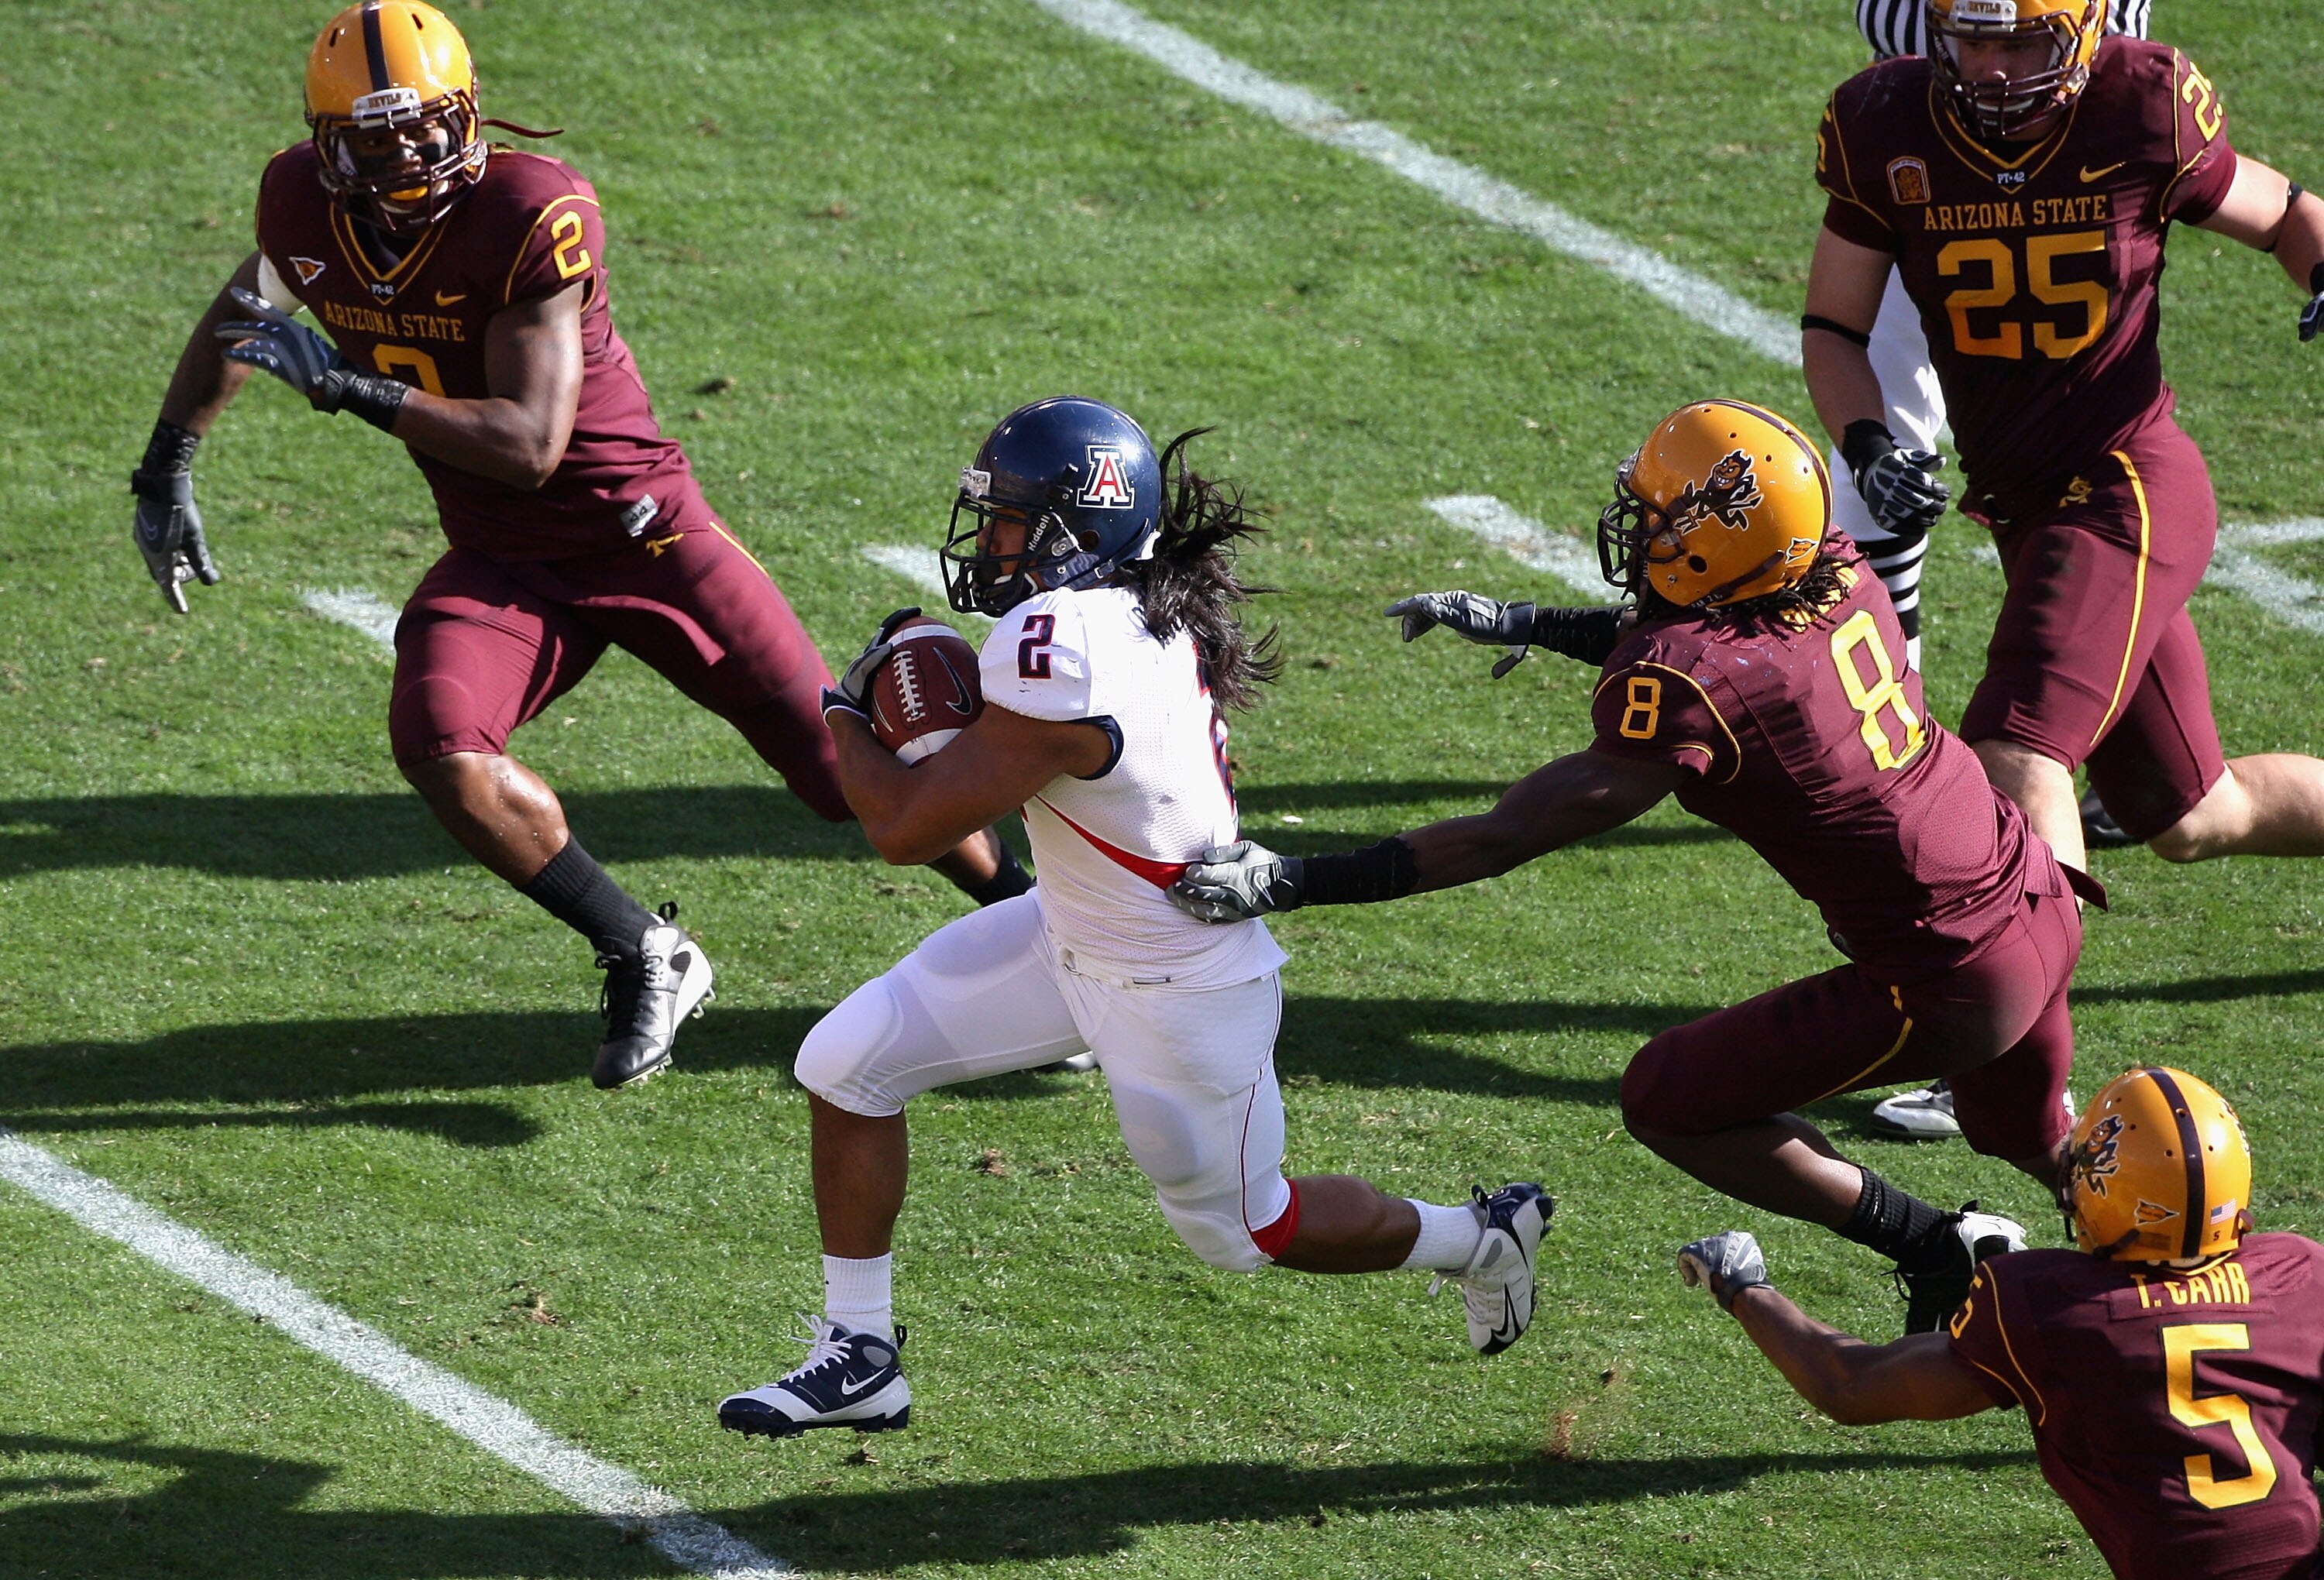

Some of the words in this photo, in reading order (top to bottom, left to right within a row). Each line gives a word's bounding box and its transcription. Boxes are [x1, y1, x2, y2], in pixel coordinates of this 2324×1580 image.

[1923, 201, 2025, 232] ARIZONA
[2033, 194, 2106, 225] STATE
[550, 210, 593, 280] 2
[324, 300, 398, 336] ARIZONA
[401, 314, 466, 342] STATE
[1937, 230, 2109, 359] 25
[1077, 445, 1135, 509] A
[1027, 514, 1050, 551] Riddell
[1017, 613, 1057, 679] 2
[1619, 677, 1661, 740] 8
[1829, 608, 1928, 771] 8
[2212, 1231, 2221, 1241] 5
[2130, 1274, 2162, 1309] T.
[2163, 1262, 2251, 1305] CARR
[2161, 1322, 2278, 1511] 5
